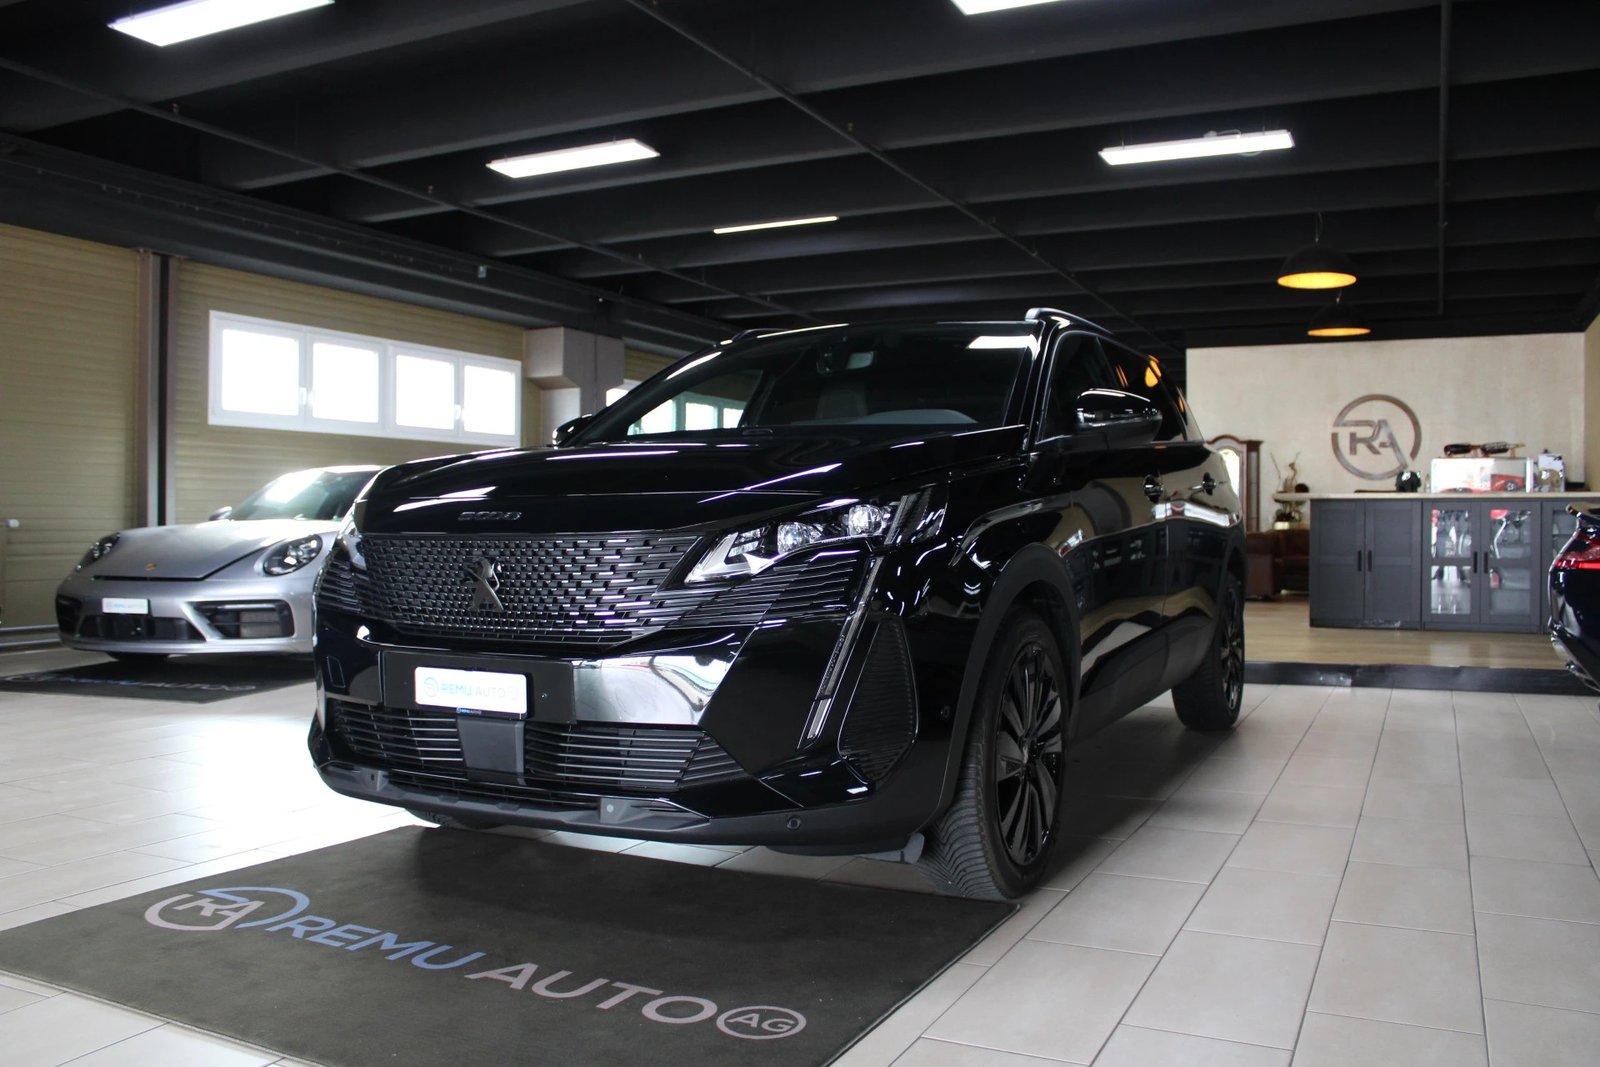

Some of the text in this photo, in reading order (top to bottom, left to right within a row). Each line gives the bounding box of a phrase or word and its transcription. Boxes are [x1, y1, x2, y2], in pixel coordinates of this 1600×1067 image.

[440, 683, 473, 696] REMU
[475, 686, 506, 698] AUTO
[265, 914, 718, 1024] REMU AUTO
[726, 1012, 796, 1032] AG
